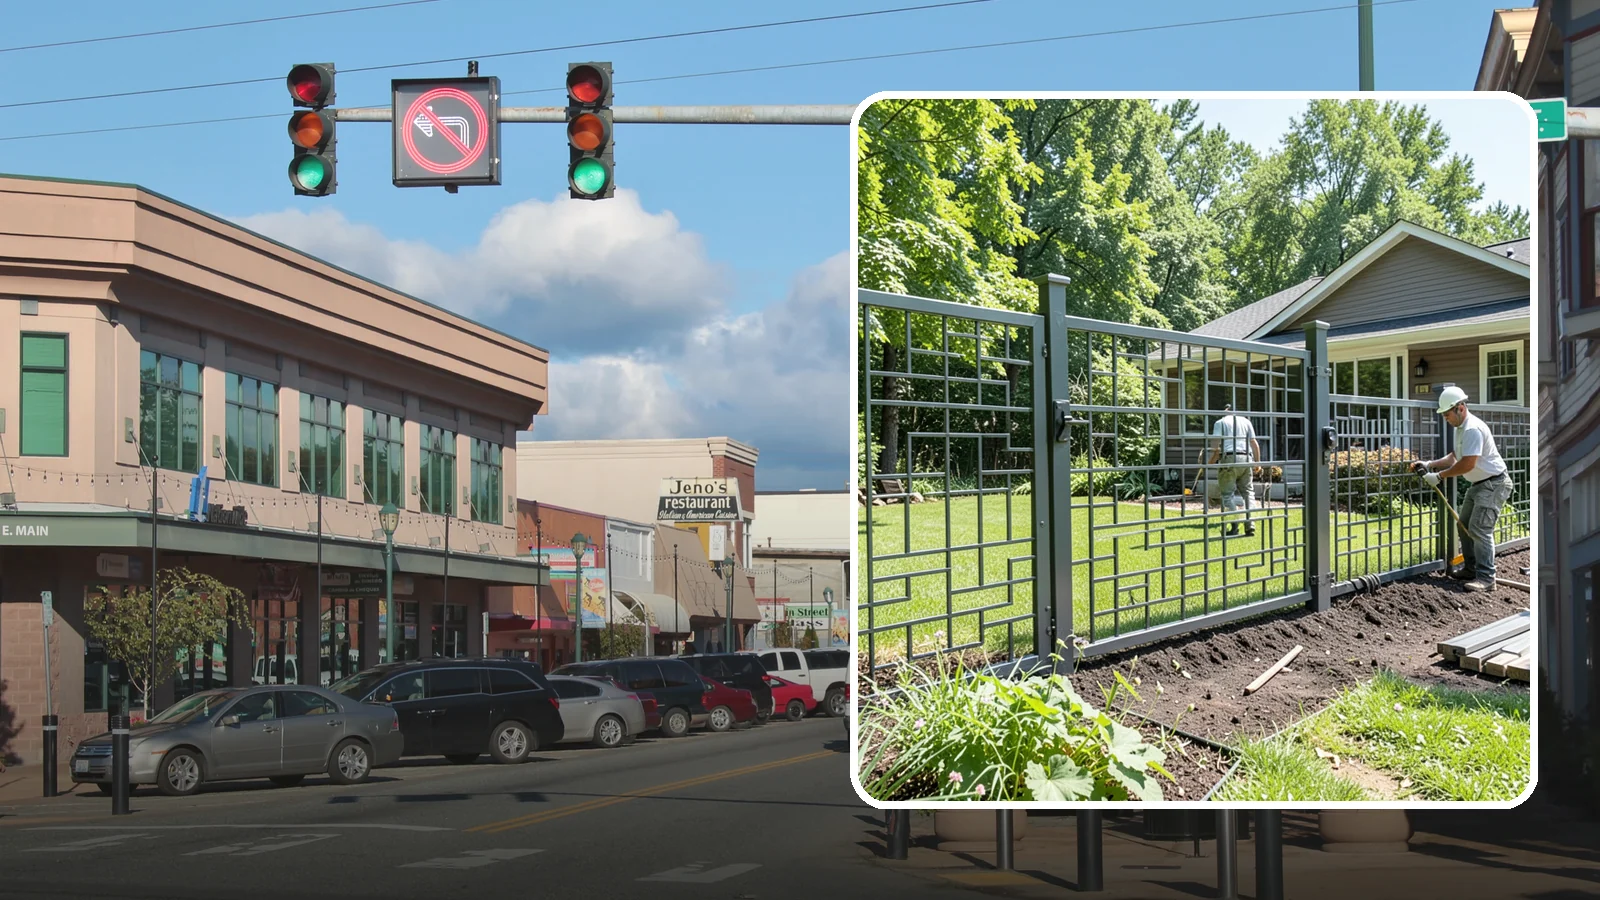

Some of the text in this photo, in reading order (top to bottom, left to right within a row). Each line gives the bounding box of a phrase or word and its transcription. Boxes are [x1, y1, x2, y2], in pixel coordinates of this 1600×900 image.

[670, 480, 727, 494] Jeno's
[665, 496, 731, 509] restaurant
[658, 509, 682, 519] Italian
[686, 510, 714, 519] American
[715, 509, 737, 519] Cuisine
[2, 525, 49, 536] E. MAIN
[797, 607, 828, 617] Street
[790, 619, 824, 627] lass
